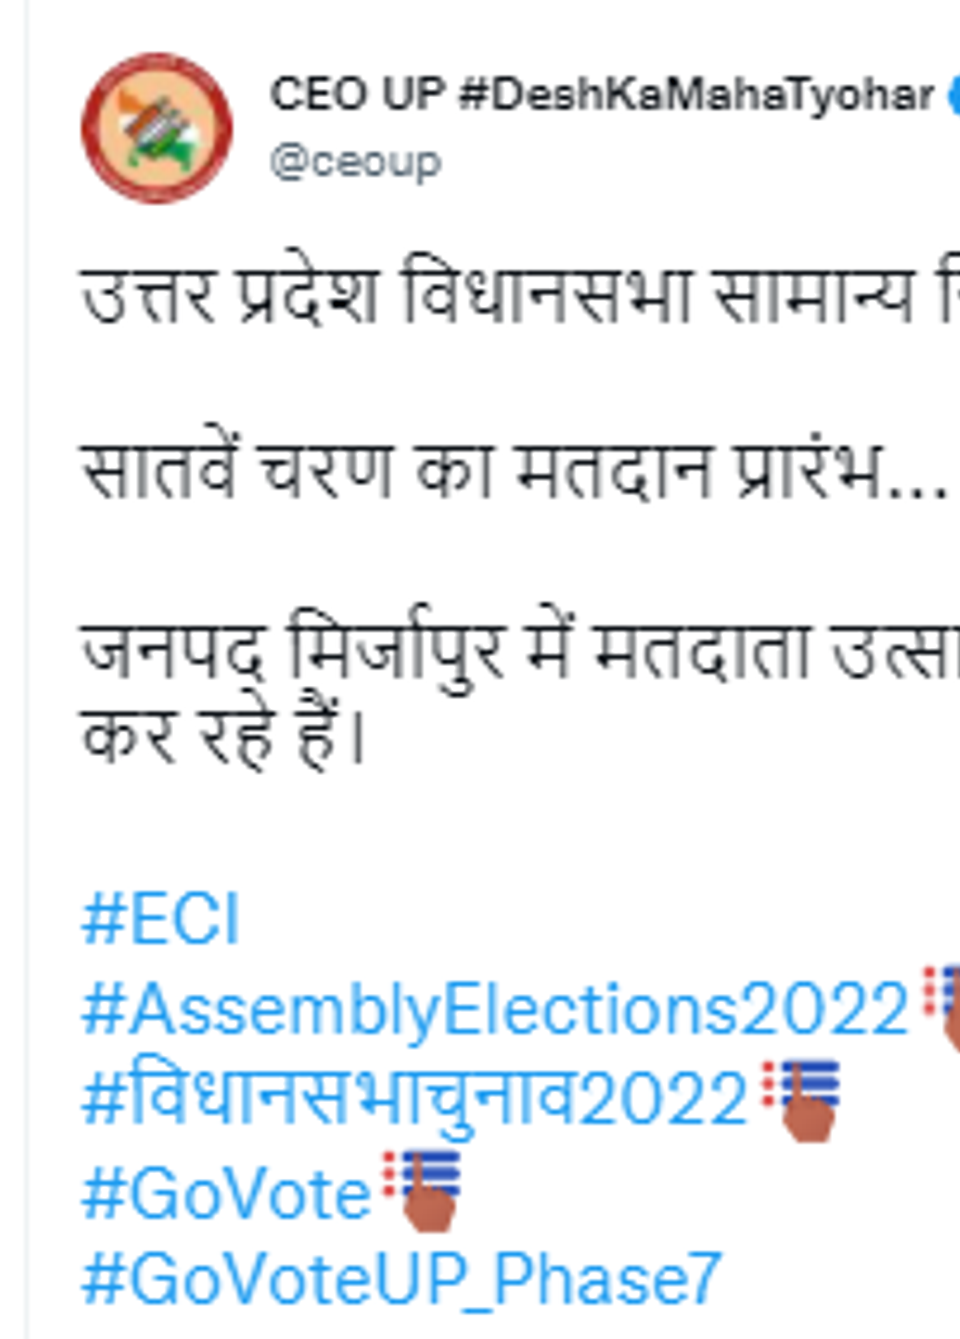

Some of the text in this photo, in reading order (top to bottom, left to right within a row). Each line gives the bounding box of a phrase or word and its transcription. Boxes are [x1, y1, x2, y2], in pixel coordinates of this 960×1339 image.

[271, 75, 935, 120] CEO UP #DeshKaMahaTyohar
[271, 142, 441, 185] @ceoup
[78, 270, 219, 324] उत्तर
[233, 246, 382, 328] प्रदेश
[398, 251, 696, 323] विधानसभा
[710, 270, 917, 323] सामान्य
[78, 421, 946, 503] सातवें चरण का मतदान प्रारंभ...
[78, 625, 269, 682] जनपद
[284, 601, 508, 697] मिर्जापुर
[522, 601, 575, 678] में
[590, 625, 814, 683] मतदाता
[78, 710, 180, 764] कर
[196, 688, 277, 774] रहे
[81, 891, 239, 945] #ECI
[81, 981, 908, 1049] #AssemblyElections2022
[81, 1052, 746, 1144] #विधानसभाचुनाव2022
[81, 1166, 371, 1220] #GoVote
[81, 1251, 723, 1314] #GoVoteUP_Phase7
